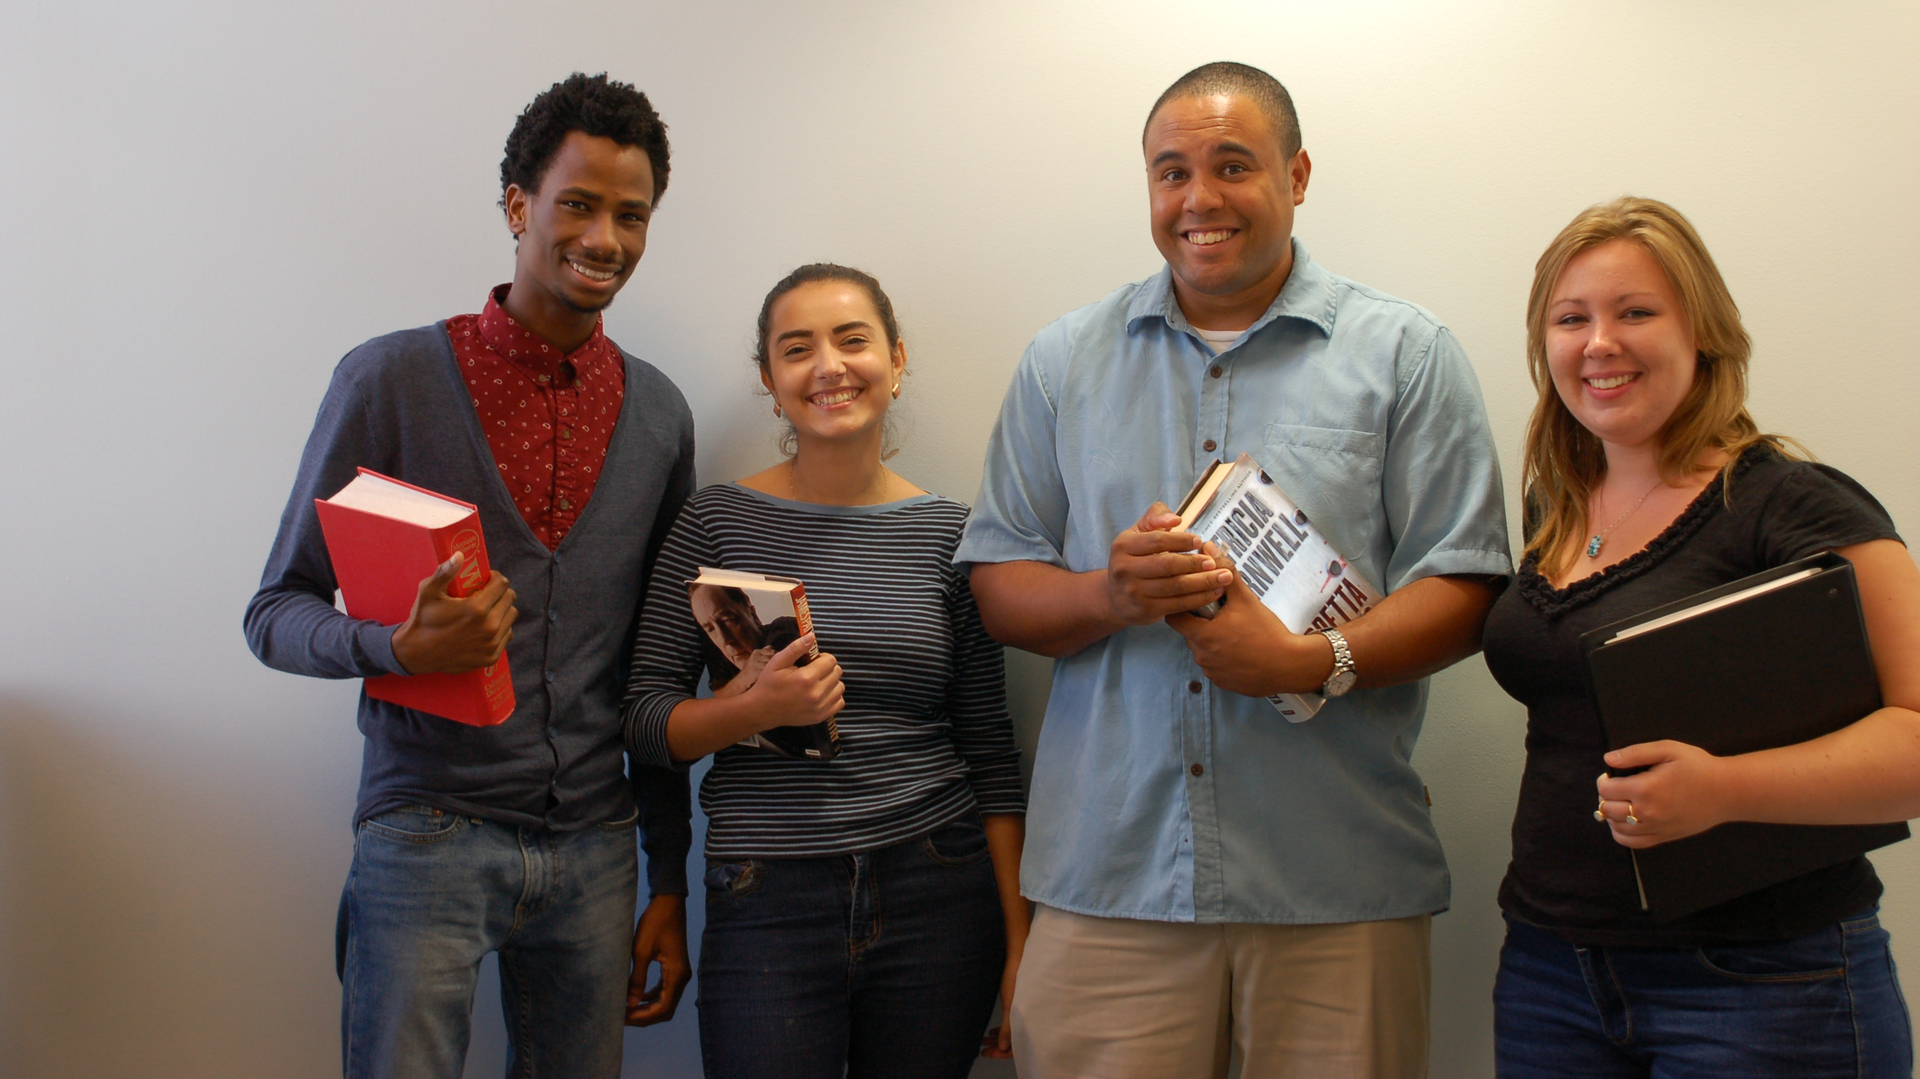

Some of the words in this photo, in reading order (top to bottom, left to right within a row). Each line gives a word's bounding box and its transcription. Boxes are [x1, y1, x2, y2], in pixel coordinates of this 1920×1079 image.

[1236, 470, 1252, 489] AUTHOR
[1239, 513, 1309, 597] RNWELL
[795, 594, 810, 619] JAMES
